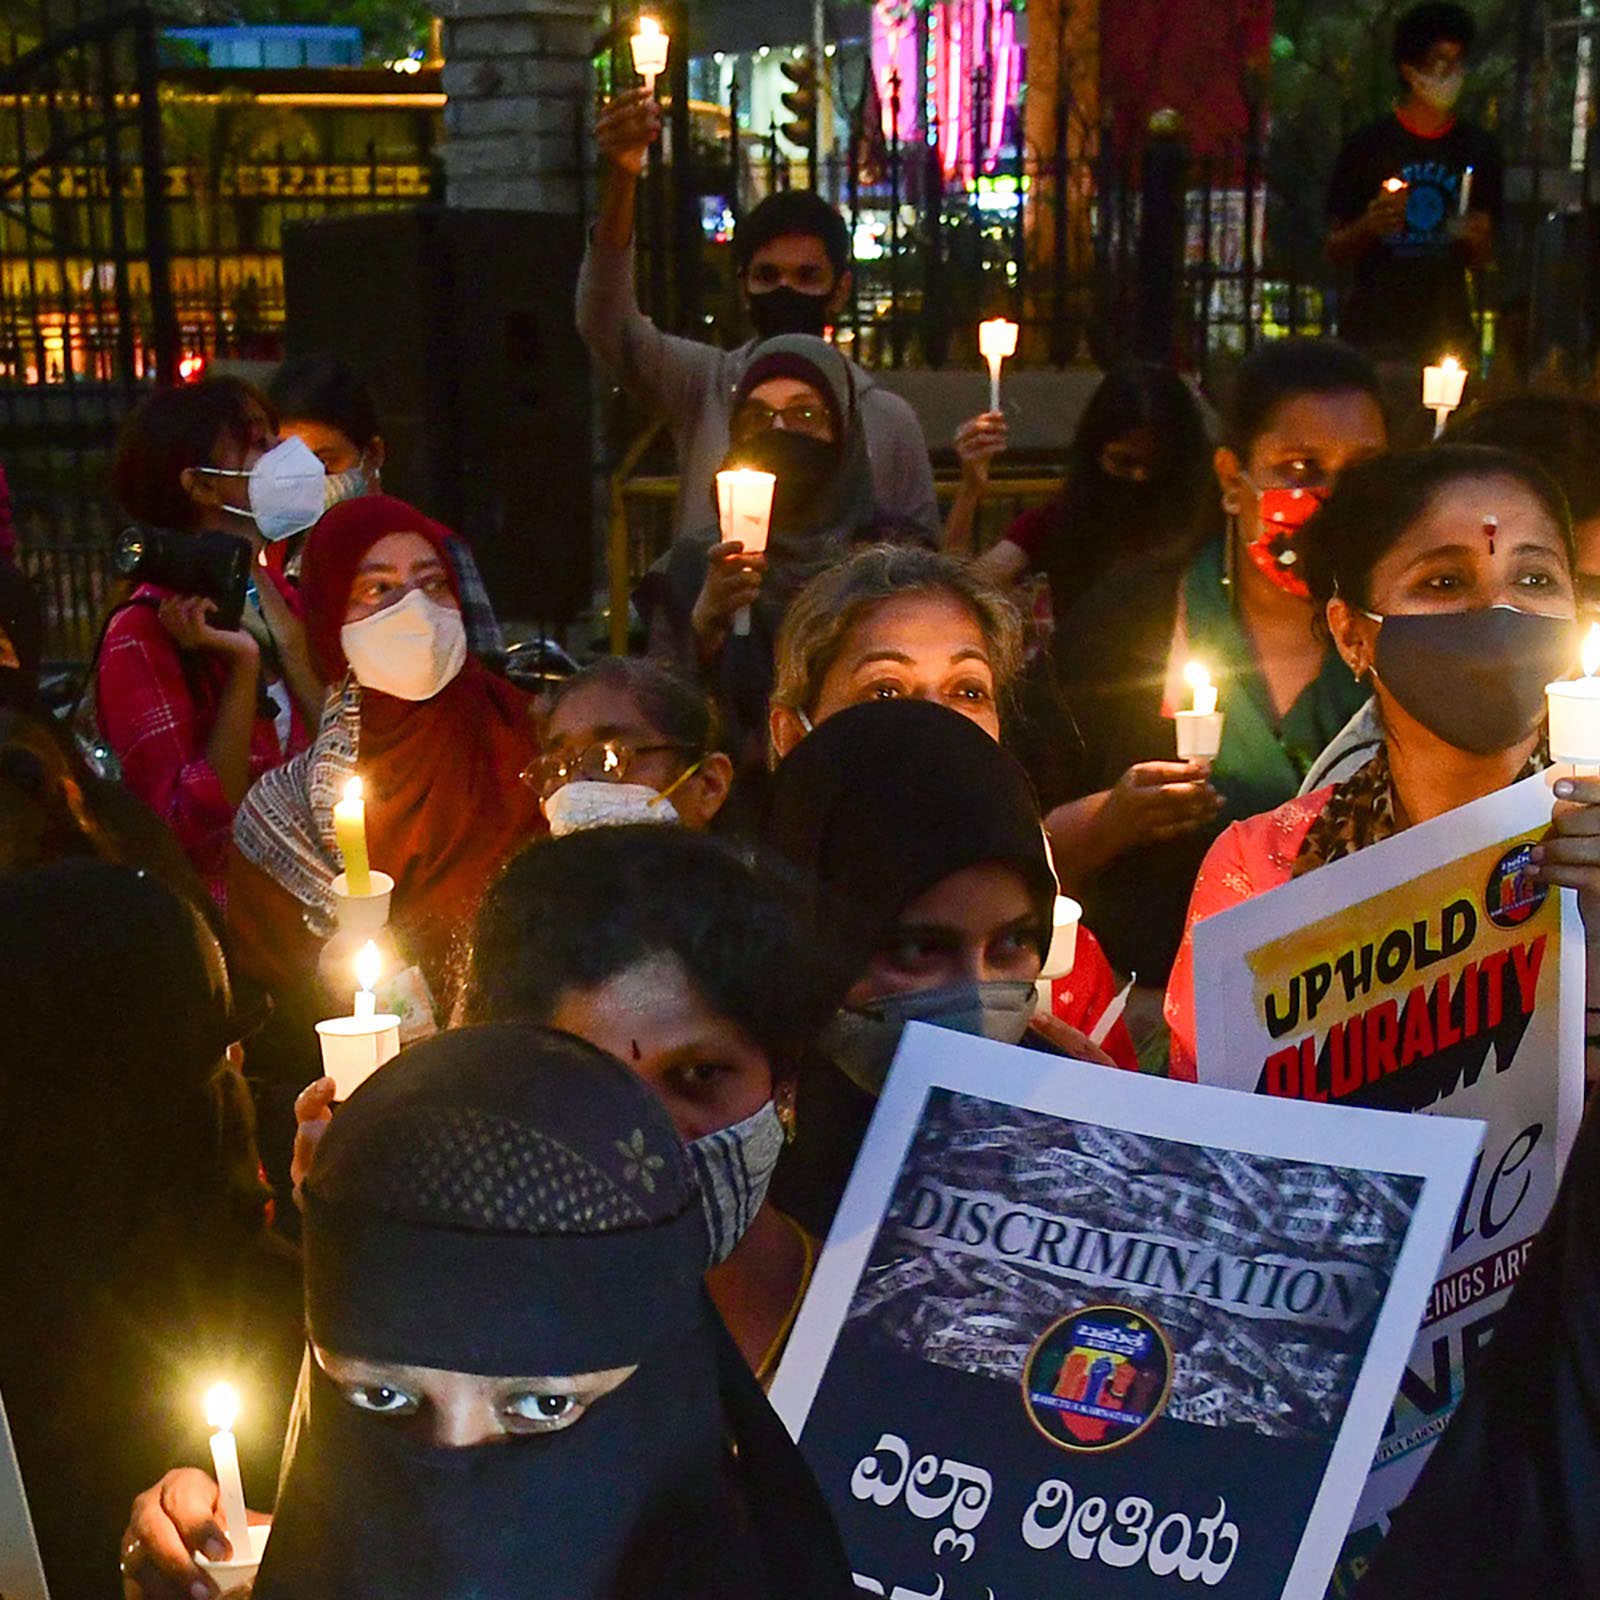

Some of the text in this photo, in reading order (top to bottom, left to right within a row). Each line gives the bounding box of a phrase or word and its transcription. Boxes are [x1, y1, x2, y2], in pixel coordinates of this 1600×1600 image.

[1264, 898, 1477, 1039] UPHOLD
[1266, 933, 1548, 1104] PLURALITY
[902, 1185, 1357, 1319] DISCRIMINATION
[850, 1433, 1240, 1586] ಎಲ್ಲಾ ರೀತಿಯ
